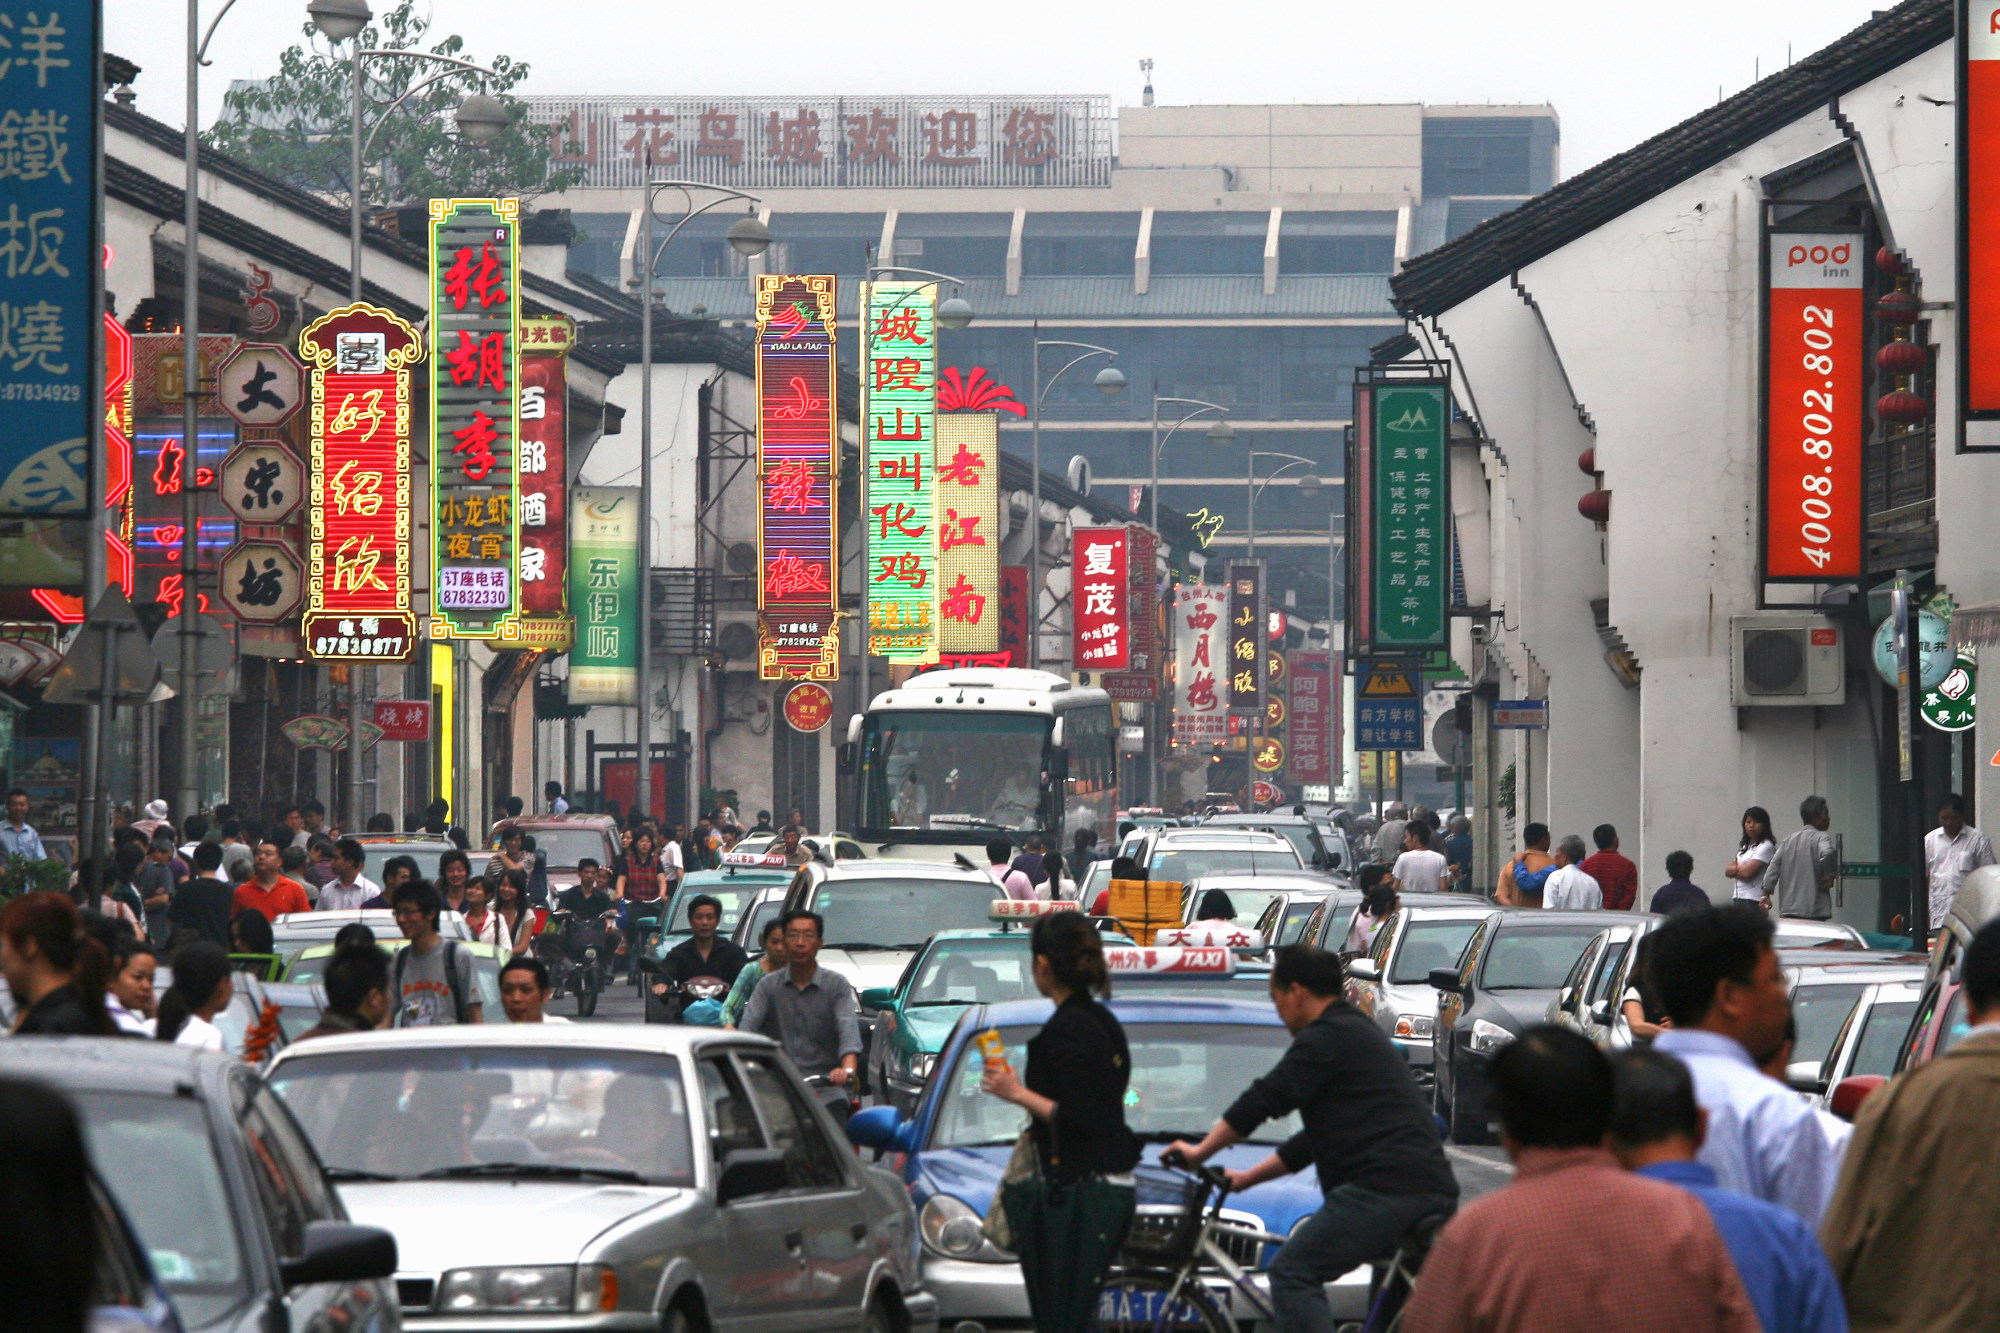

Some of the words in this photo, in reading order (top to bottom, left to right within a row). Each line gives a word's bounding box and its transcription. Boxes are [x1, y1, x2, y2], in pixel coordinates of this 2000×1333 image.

[1788, 243, 1850, 267] pod
[1823, 266, 1849, 277] inn
[1801, 305, 1833, 568] 4008.802.802
[871, 307, 928, 588] 城隍山叫化鸡
[441, 494, 511, 528] 小龙虾
[938, 444, 986, 624] 老江南
[447, 532, 504, 559] 夜宵
[444, 571, 505, 587] 订座电话
[1083, 542, 1117, 616] 复茂
[443, 589, 505, 605] 87832330
[587, 557, 619, 658] 东伊顺
[522, 621, 566, 630] 7827772
[522, 633, 566, 641] 7827773
[1885, 641, 1947, 653] 西龍井
[1187, 603, 1218, 711] 西月楼
[380, 708, 423, 729] 烧烤
[1361, 708, 1416, 723] 前方学校
[1361, 728, 1416, 743] 避让学生
[766, 856, 783, 864] TAXI
[1099, 950, 1158, 969] 州外事
[1183, 952, 1221, 967] TAXI
